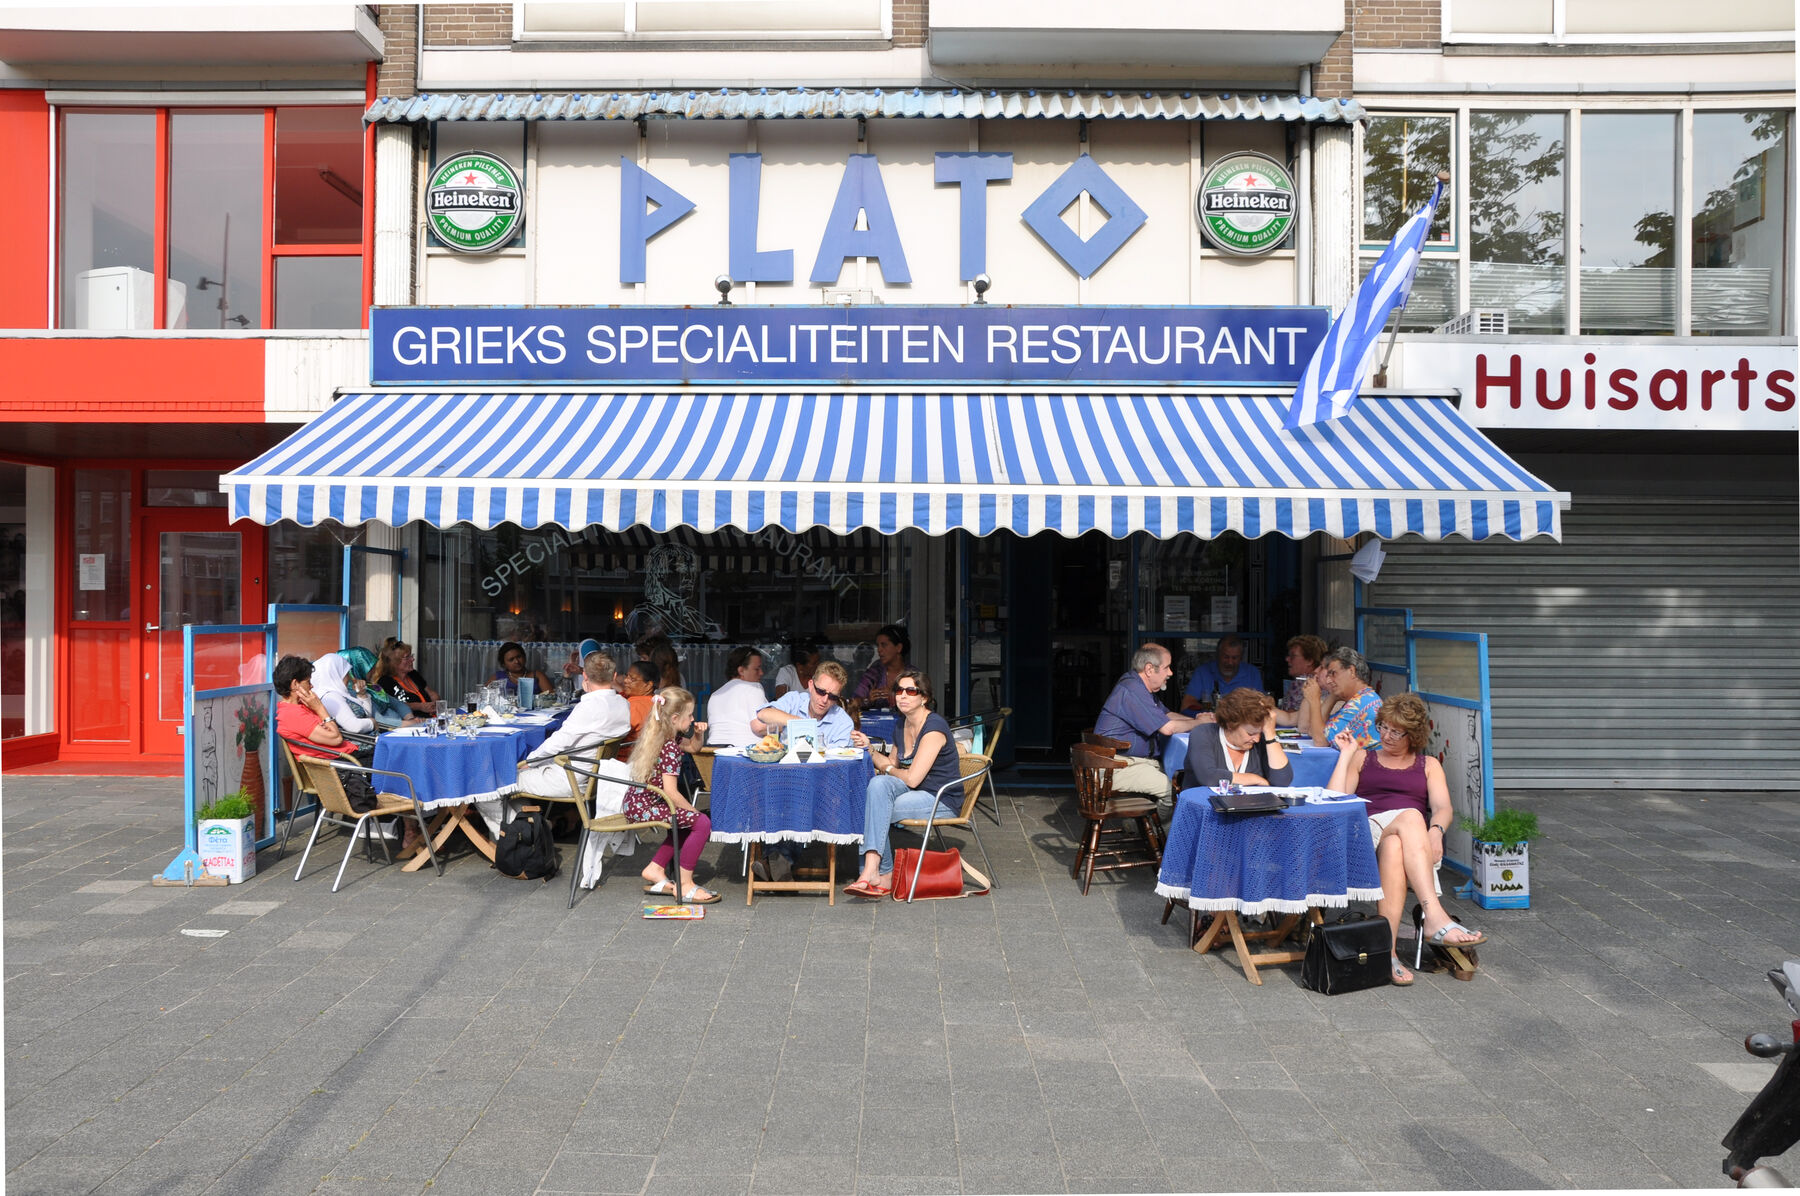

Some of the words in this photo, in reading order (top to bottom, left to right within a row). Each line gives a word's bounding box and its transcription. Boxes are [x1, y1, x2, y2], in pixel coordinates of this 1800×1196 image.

[440, 161, 473, 182] HEINEKEN
[474, 161, 506, 182] PILSENER
[1216, 163, 1250, 183] HEINEKEN
[1251, 163, 1282, 184] PILSENER
[434, 191, 511, 208] Heineken
[1210, 193, 1288, 210] Heineken
[620, 152, 1148, 283] PLATO
[439, 218, 472, 241] PREMIUM
[474, 218, 506, 241] QUALITY
[1215, 220, 1249, 243] PREMIUM
[1252, 220, 1282, 243] QUALITY
[392, 326, 567, 365] GRIEKS
[586, 324, 964, 364] SPECIALITEITEN
[987, 325, 1307, 366] RESTAURANT
[1476, 352, 1796, 412] Huisarts
